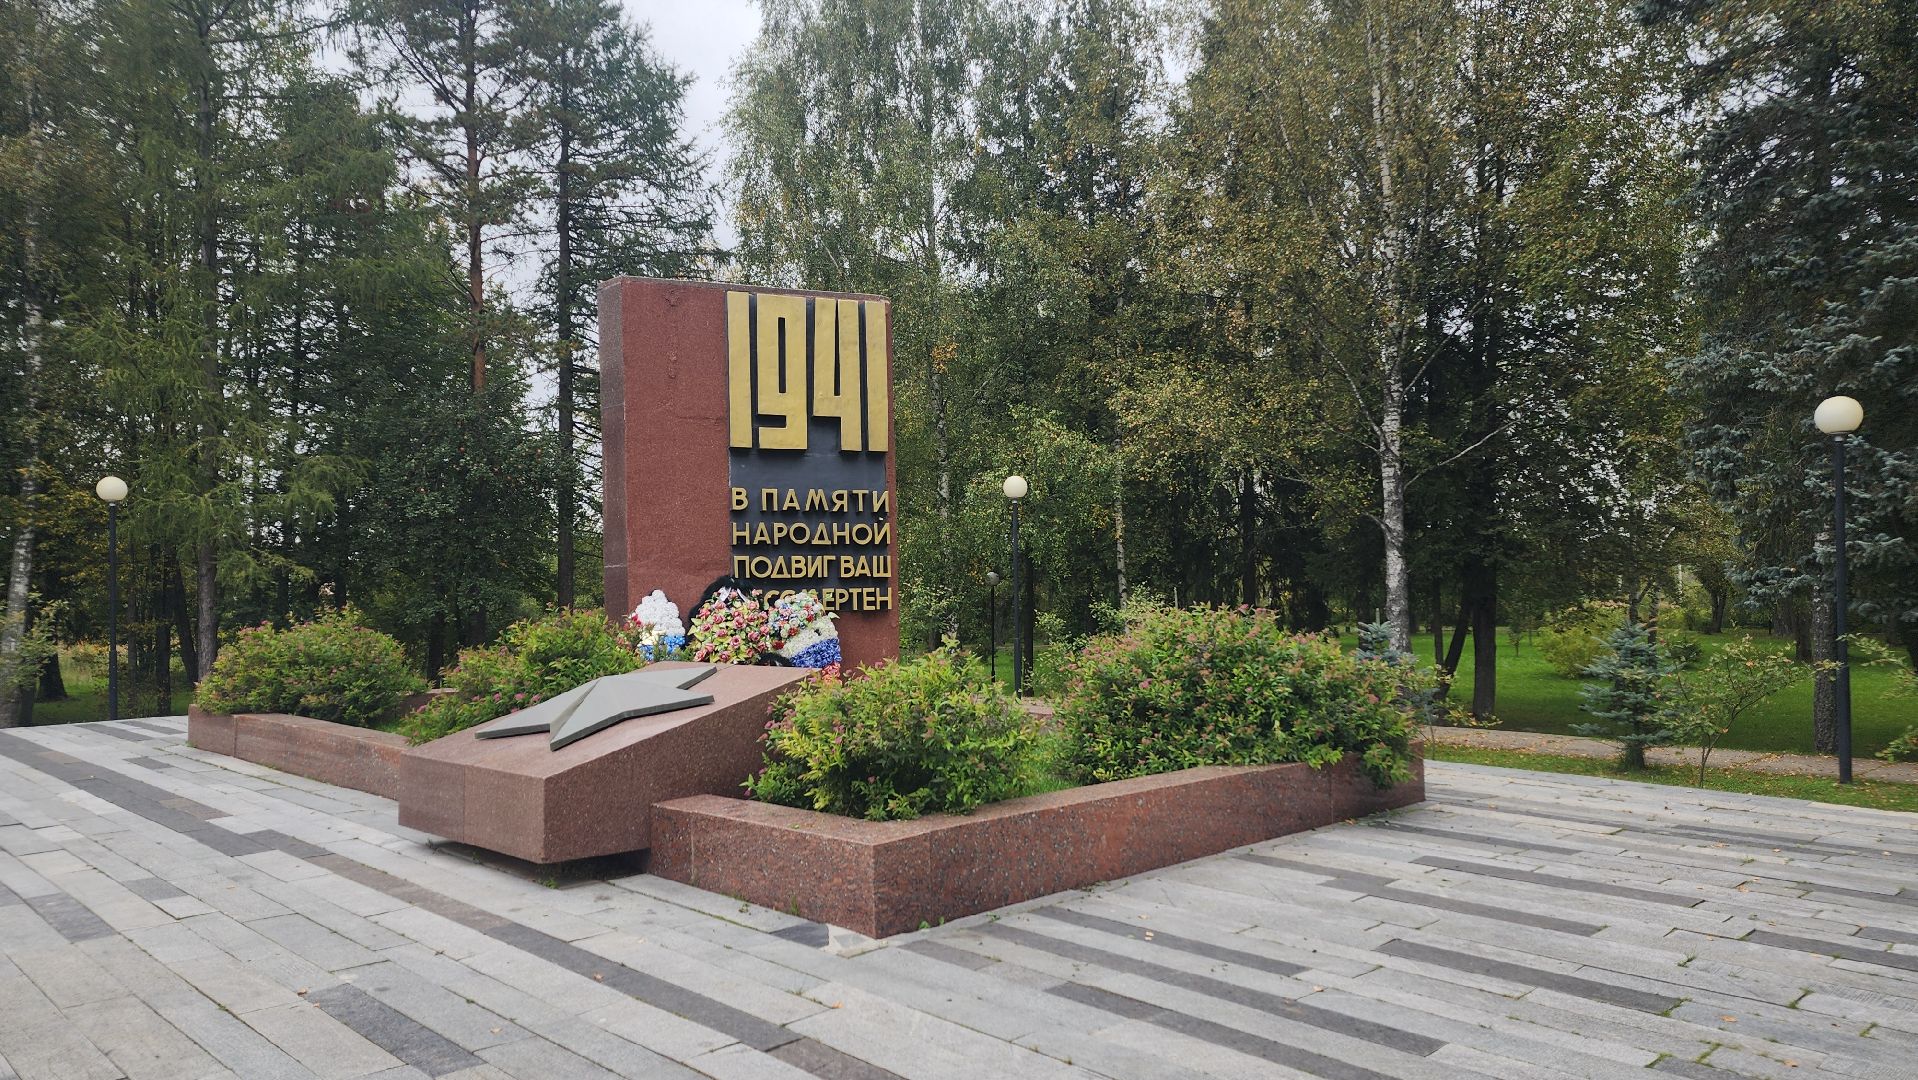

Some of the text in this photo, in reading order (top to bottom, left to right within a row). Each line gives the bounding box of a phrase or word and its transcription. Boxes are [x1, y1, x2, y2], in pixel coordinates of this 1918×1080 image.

[727, 291, 888, 452] 1941
[732, 487, 889, 513] В ПАМЯТИ
[732, 517, 890, 545] НАРОДНОЙ
[733, 555, 891, 578] ПОДВИГ ВАШ
